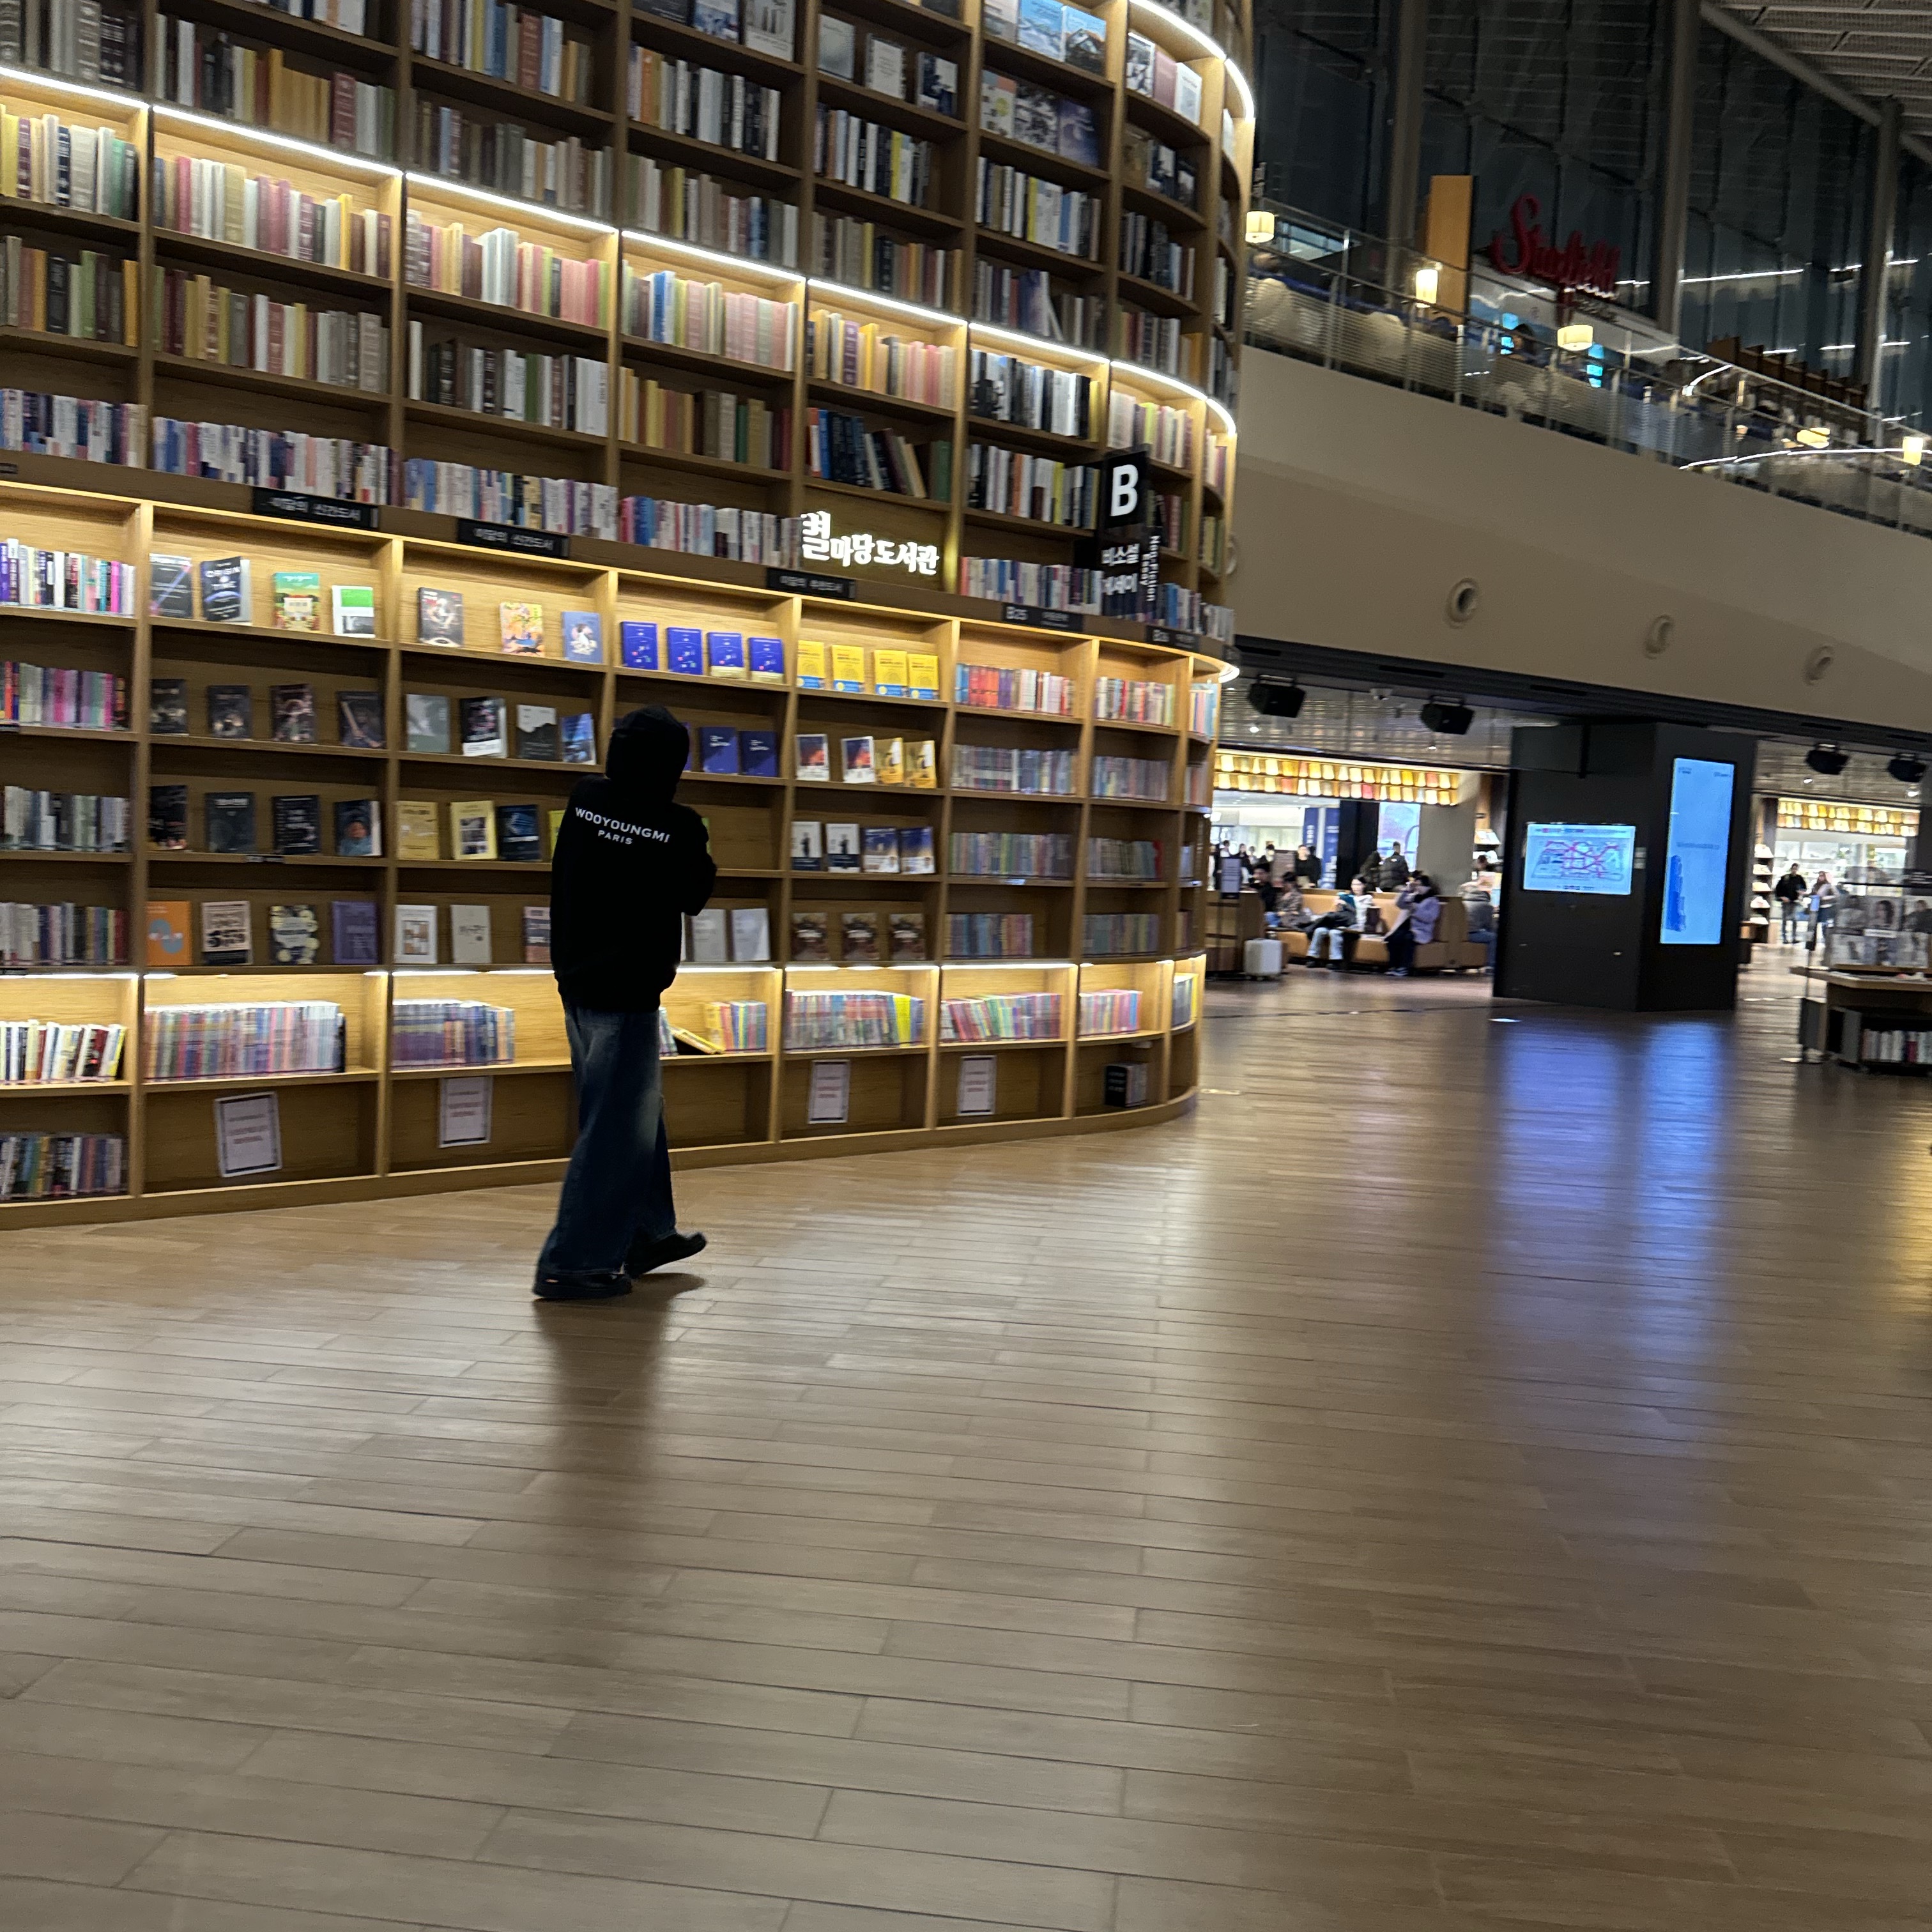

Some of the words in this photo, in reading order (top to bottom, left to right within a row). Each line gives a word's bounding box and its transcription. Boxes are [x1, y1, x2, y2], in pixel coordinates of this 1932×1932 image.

[1110, 464, 1138, 516] B
[1101, 543, 1140, 567] 비소설
[575, 807, 671, 843] WOOYOUNGMI
[597, 829, 633, 845] PARIS
